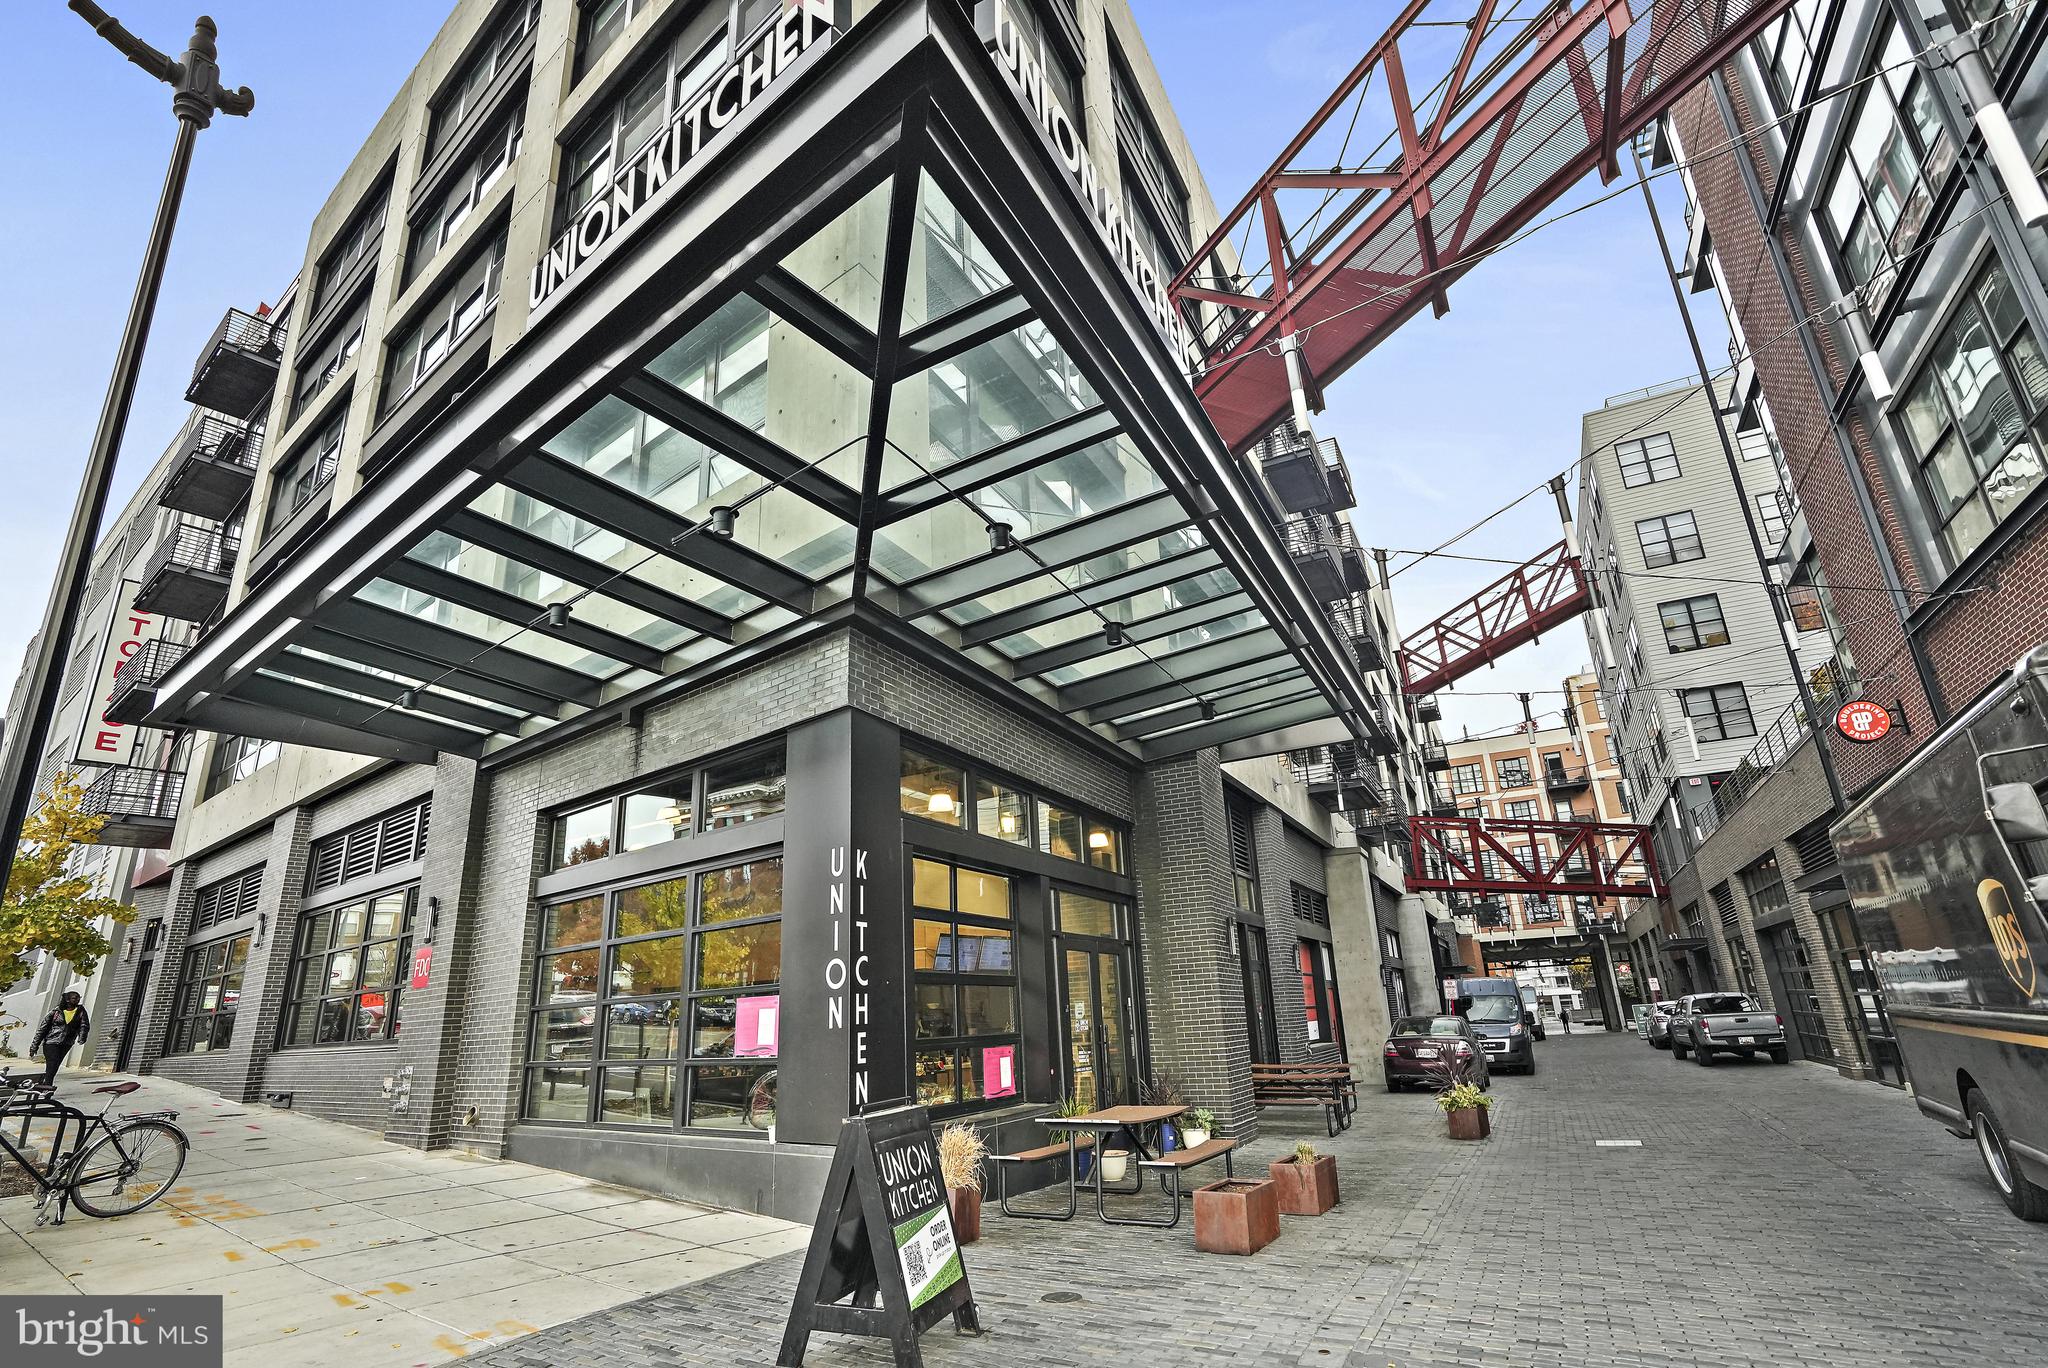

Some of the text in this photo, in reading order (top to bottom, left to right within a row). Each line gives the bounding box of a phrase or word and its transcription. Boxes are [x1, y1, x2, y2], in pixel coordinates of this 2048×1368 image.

[529, 0, 834, 309] UNION KITCHEN
[994, 0, 1193, 374] UNION KITCHEN
[1840, 704, 1885, 723] BOULDERING
[1848, 727, 1885, 739] PROJECT
[825, 846, 847, 1029] UNION
[1989, 912, 2028, 979] ups
[413, 957, 431, 978] FDC
[855, 848, 869, 1105] KITCHEN
[880, 1140, 933, 1187] UNION
[889, 1176, 938, 1219] KITCHEN
[930, 1219, 947, 1237] ORDER
[932, 1232, 951, 1252] ONLINE
